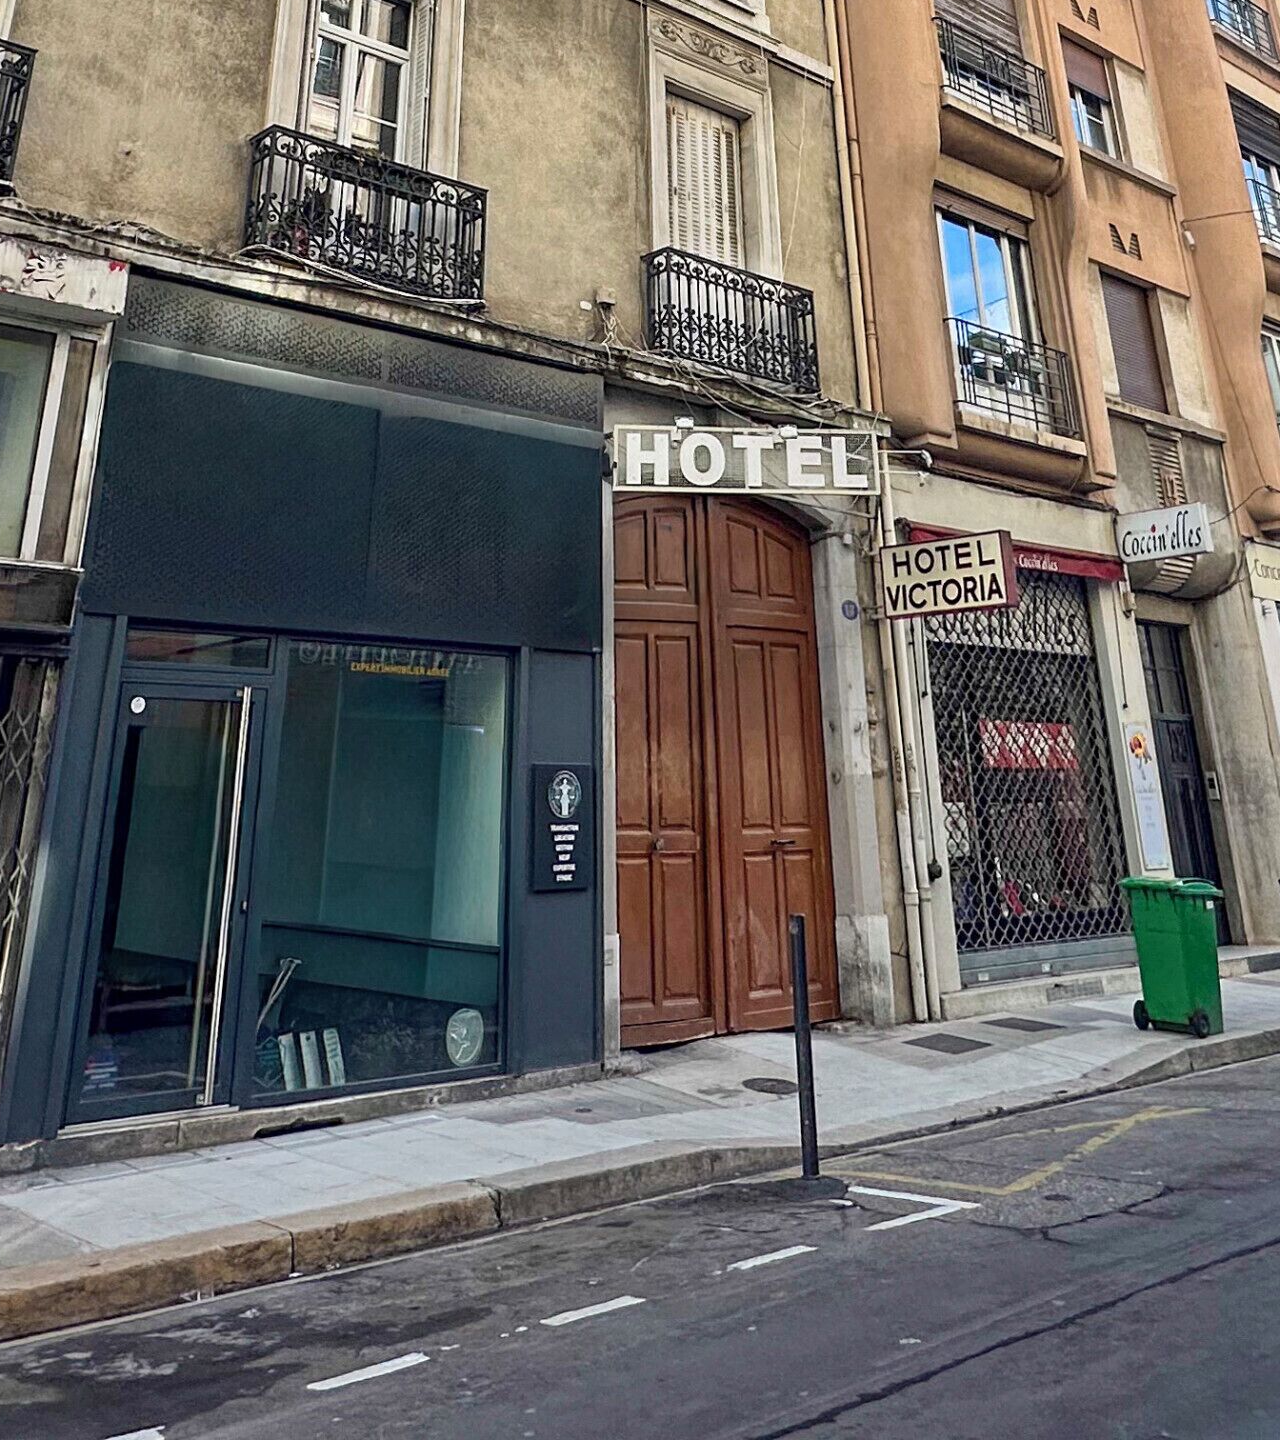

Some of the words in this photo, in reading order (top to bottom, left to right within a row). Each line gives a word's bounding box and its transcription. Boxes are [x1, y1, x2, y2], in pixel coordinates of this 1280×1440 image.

[625, 432, 868, 489] HOTEL
[1122, 510, 1202, 557] Coccin'elles
[892, 540, 996, 578] HOTEL
[886, 573, 1004, 611] VICTORIA
